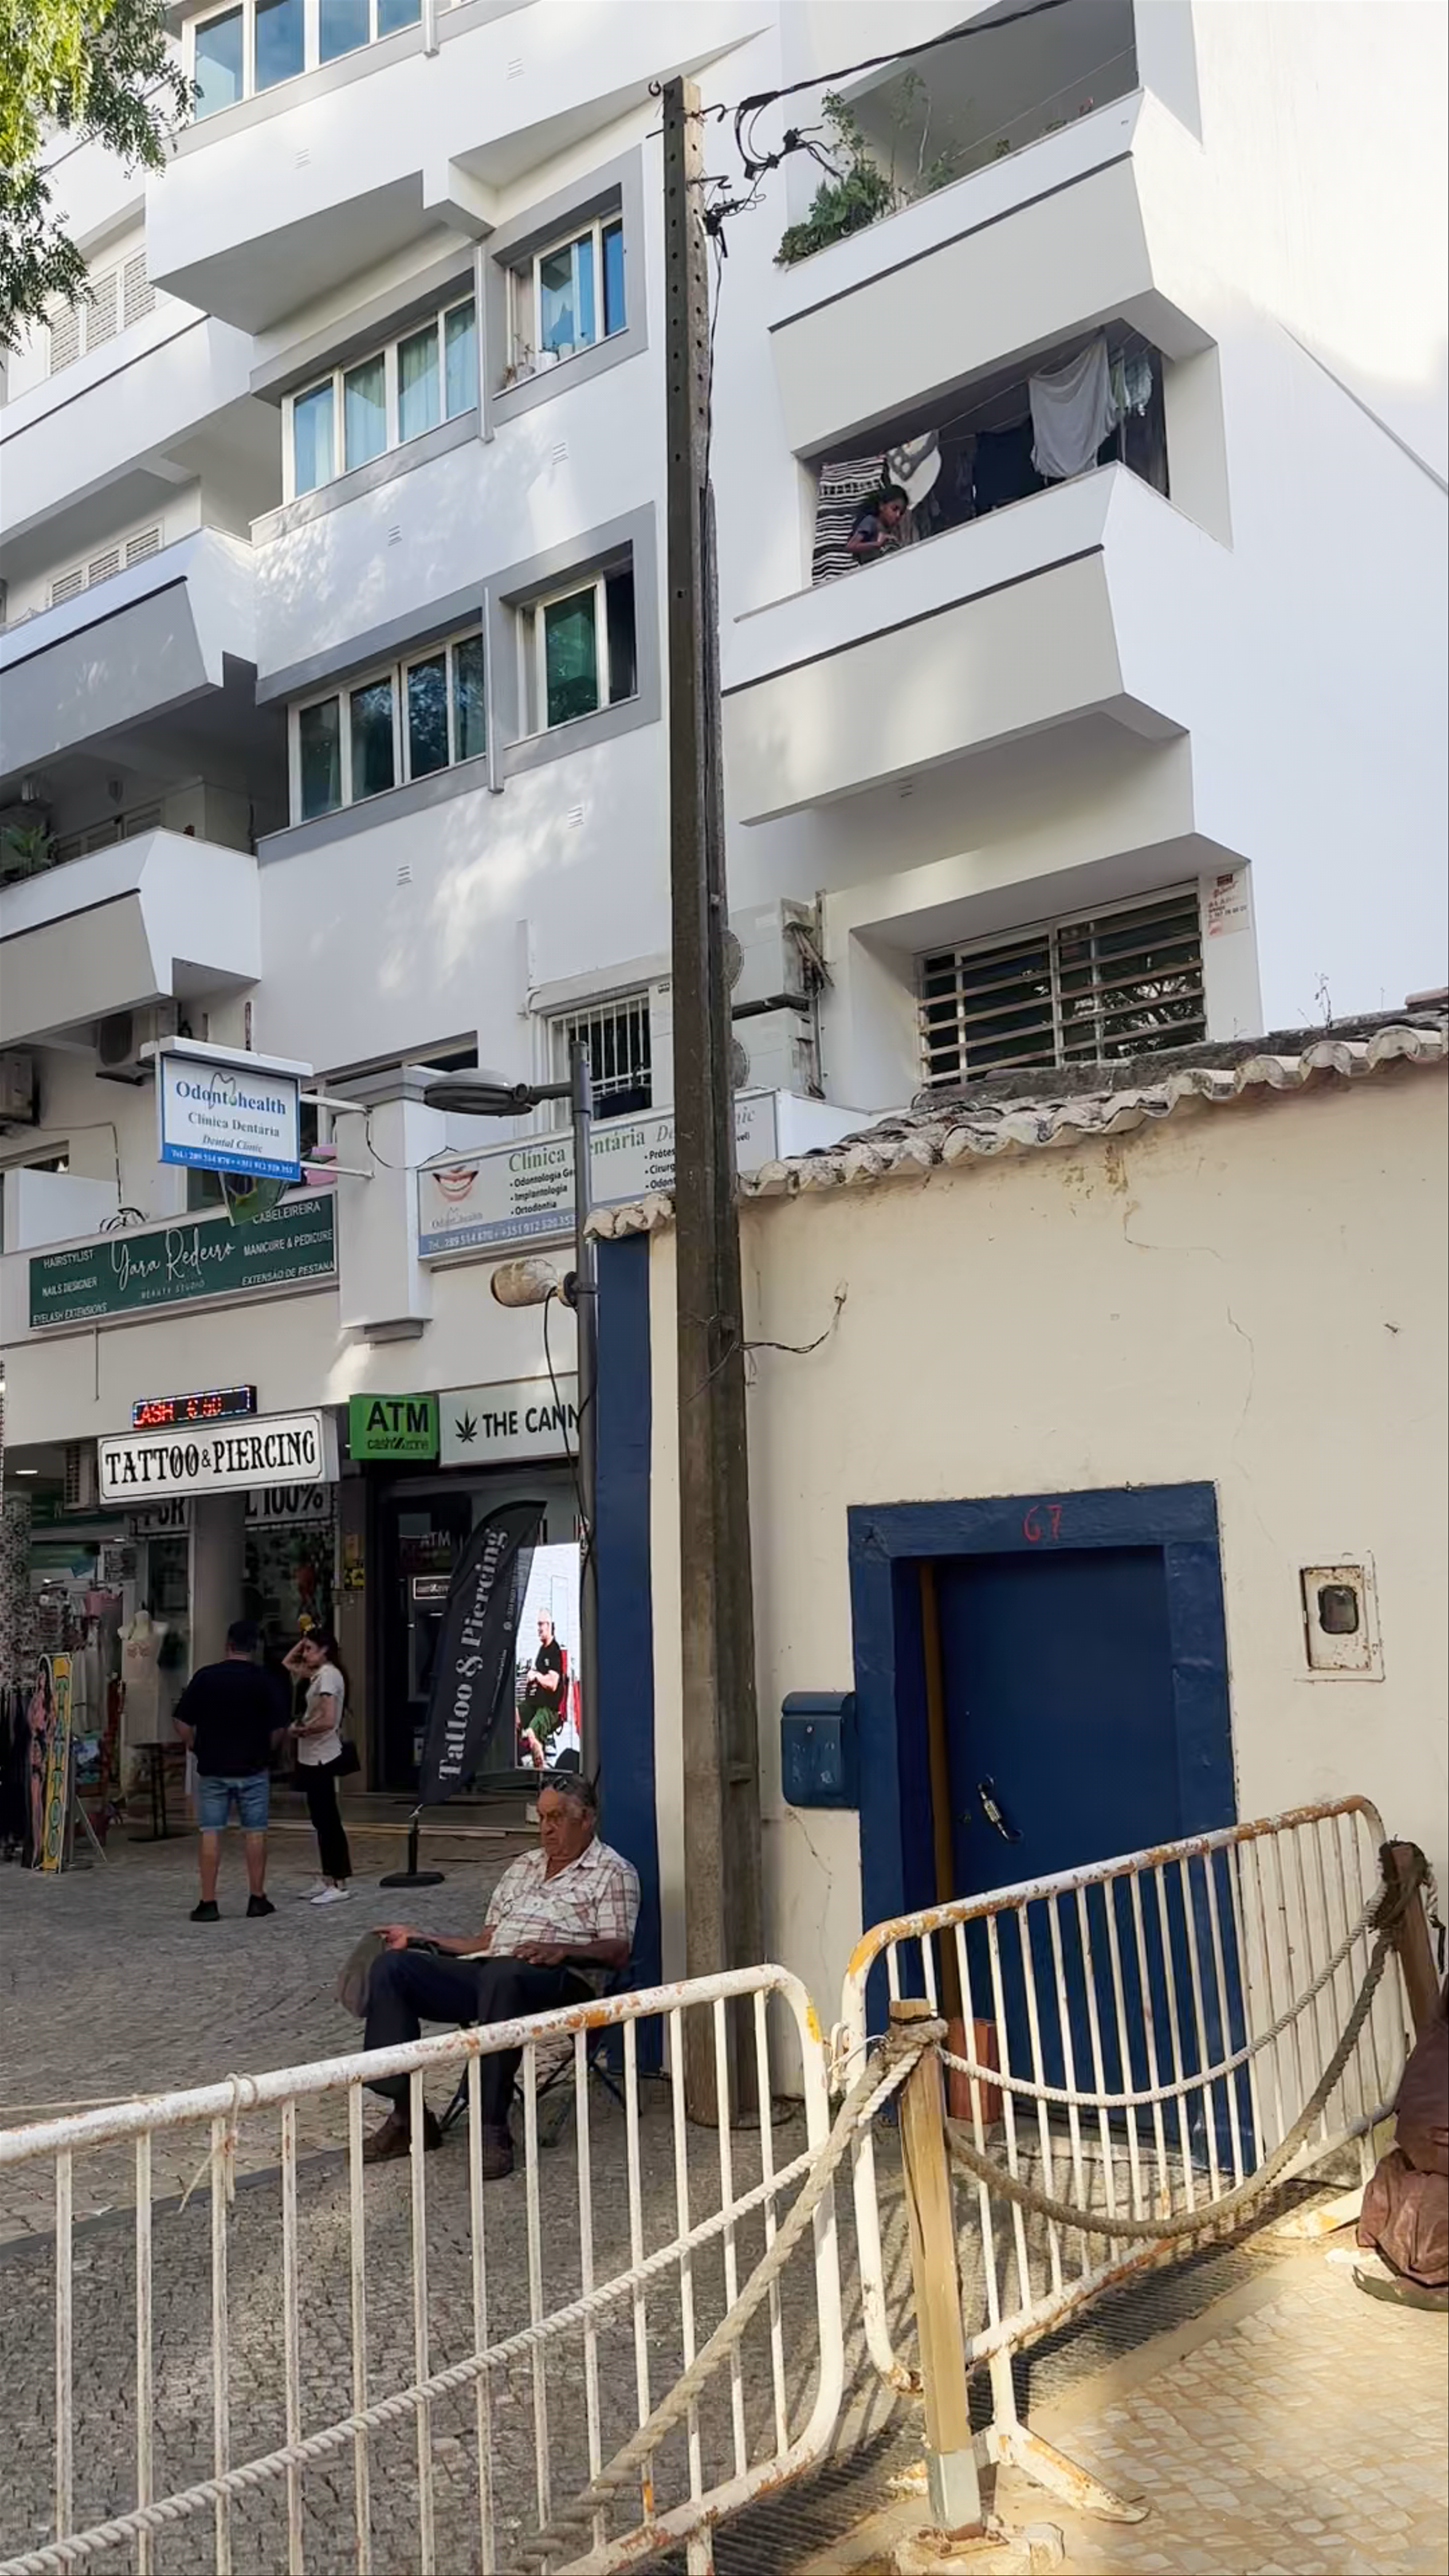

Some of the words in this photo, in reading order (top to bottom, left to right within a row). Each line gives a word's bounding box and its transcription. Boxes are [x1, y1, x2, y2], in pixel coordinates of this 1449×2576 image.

[176, 1081, 286, 1114] Odontohealth
[202, 1134, 234, 1148] Dental
[589, 1127, 645, 1155] entária
[649, 1148, 676, 1160] Prótes
[514, 1170, 561, 1187] Odontologia
[650, 1163, 676, 1174] Cirurg
[514, 1184, 568, 1201] Implantologia
[252, 1201, 321, 1224] CABELEIREIRA
[515, 1201, 557, 1215] Ortodontia
[244, 1238, 285, 1256] MANICURE
[294, 1229, 333, 1247] PEDICURE
[43, 1249, 94, 1269] HAIRSTYLIST
[111, 1241, 160, 1291] Yara
[285, 1267, 296, 1278] DE
[42, 1284, 62, 1297] NAILS
[63, 1276, 98, 1293] DESIGNER
[32, 1311, 63, 1325] EYELASH
[65, 1302, 108, 1320] EXTENSIONS
[366, 1401, 429, 1433] ATM
[483, 1410, 518, 1438] THE
[525, 1404, 578, 1433] CANN
[105, 1444, 199, 1485] TATTOO
[213, 1430, 315, 1473] PIERCING
[438, 1683, 472, 1781] Tattoo
[460, 1527, 508, 1648] Piercing
